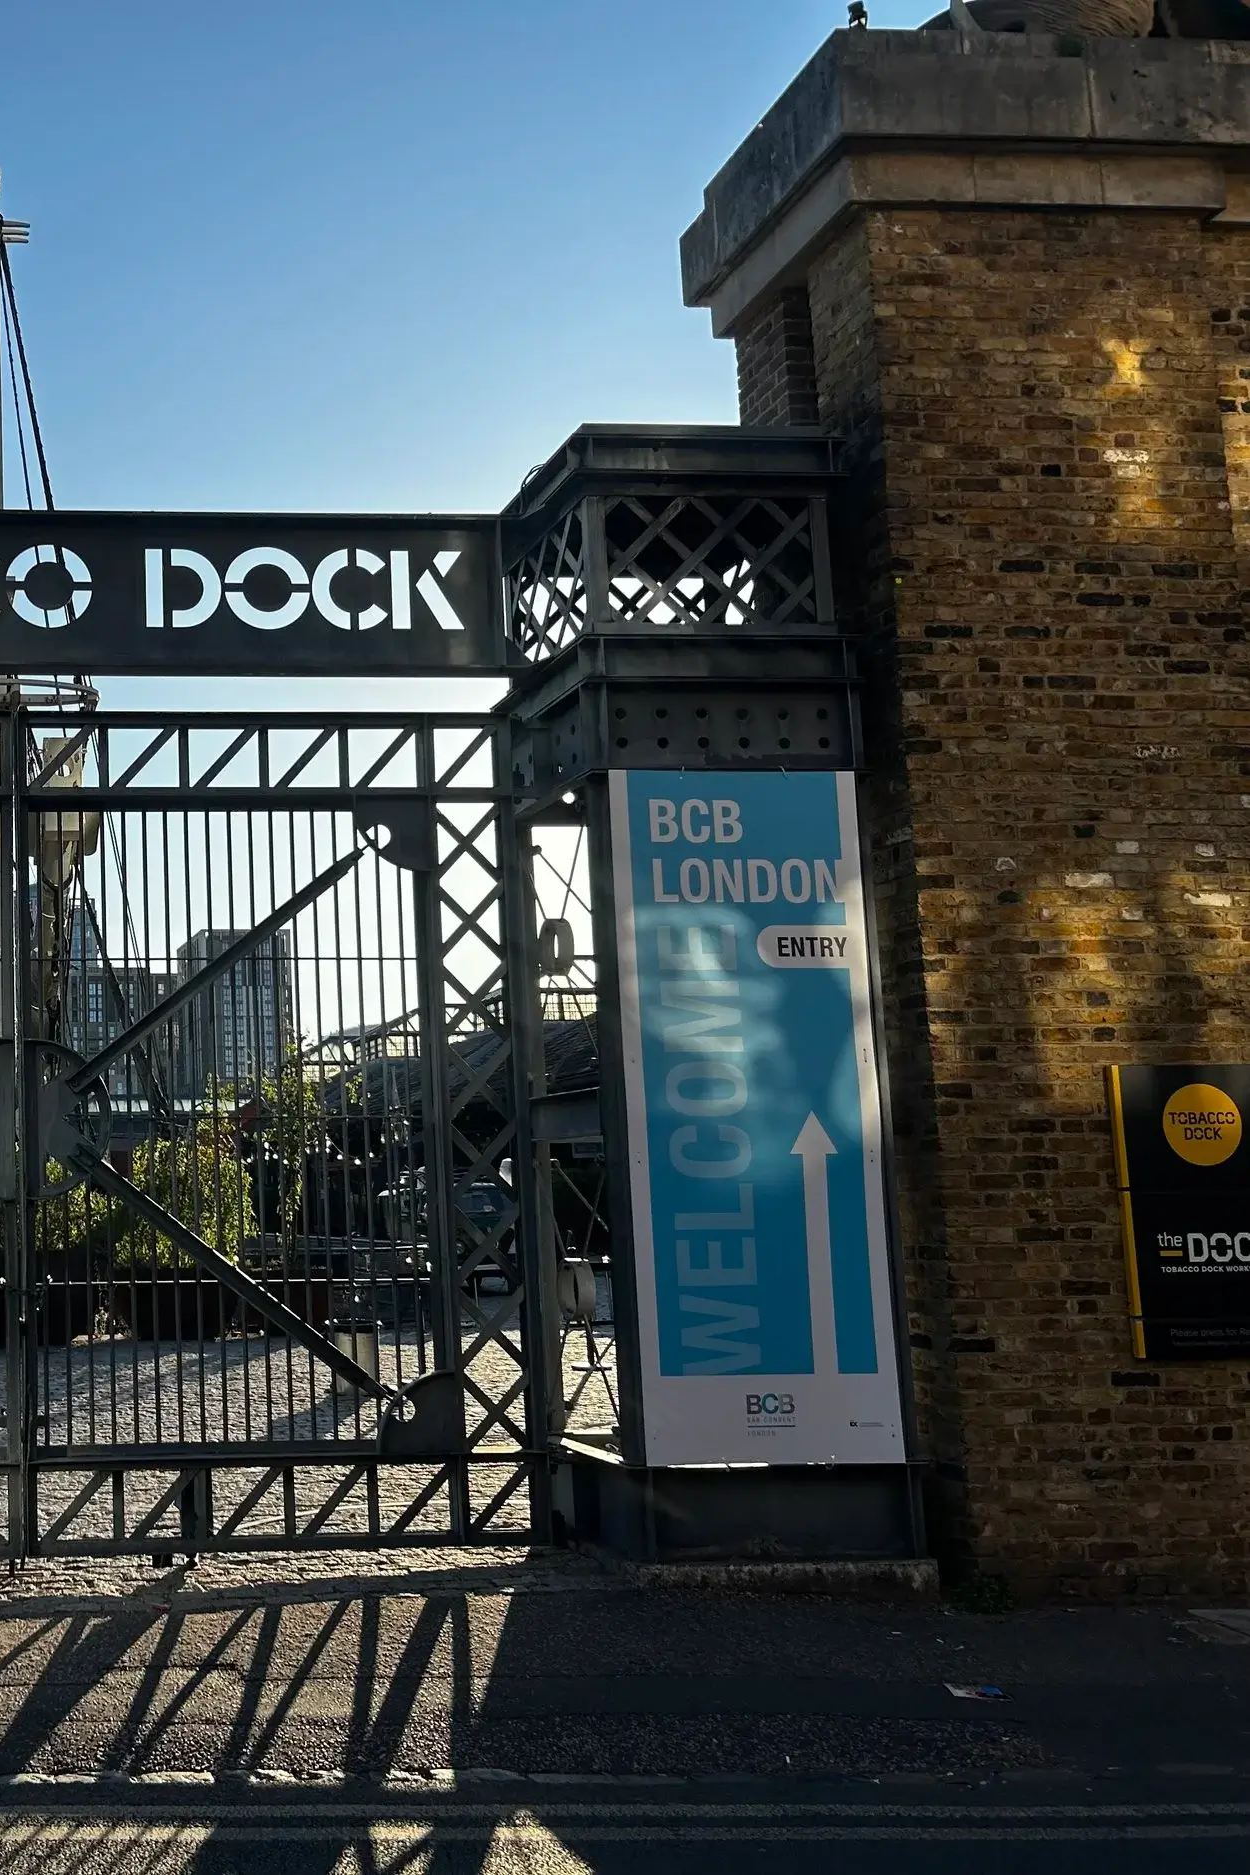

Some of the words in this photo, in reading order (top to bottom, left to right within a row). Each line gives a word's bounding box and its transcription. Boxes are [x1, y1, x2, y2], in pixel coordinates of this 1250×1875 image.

[145, 546, 466, 631] DOCK
[648, 798, 744, 844] BCB
[652, 857, 847, 904] LONDON
[776, 936, 848, 958] ENTRY
[1167, 1111, 1236, 1125] TOBACCO
[1184, 1127, 1223, 1141] DOCK
[657, 923, 762, 1376] WELCOME
[1156, 1231, 1183, 1247] the
[1201, 1265, 1225, 1273] DOCK
[1170, 1327, 1198, 1337] Please
[746, 1393, 796, 1415] BCB
[763, 1416, 796, 1424] CONVENT
